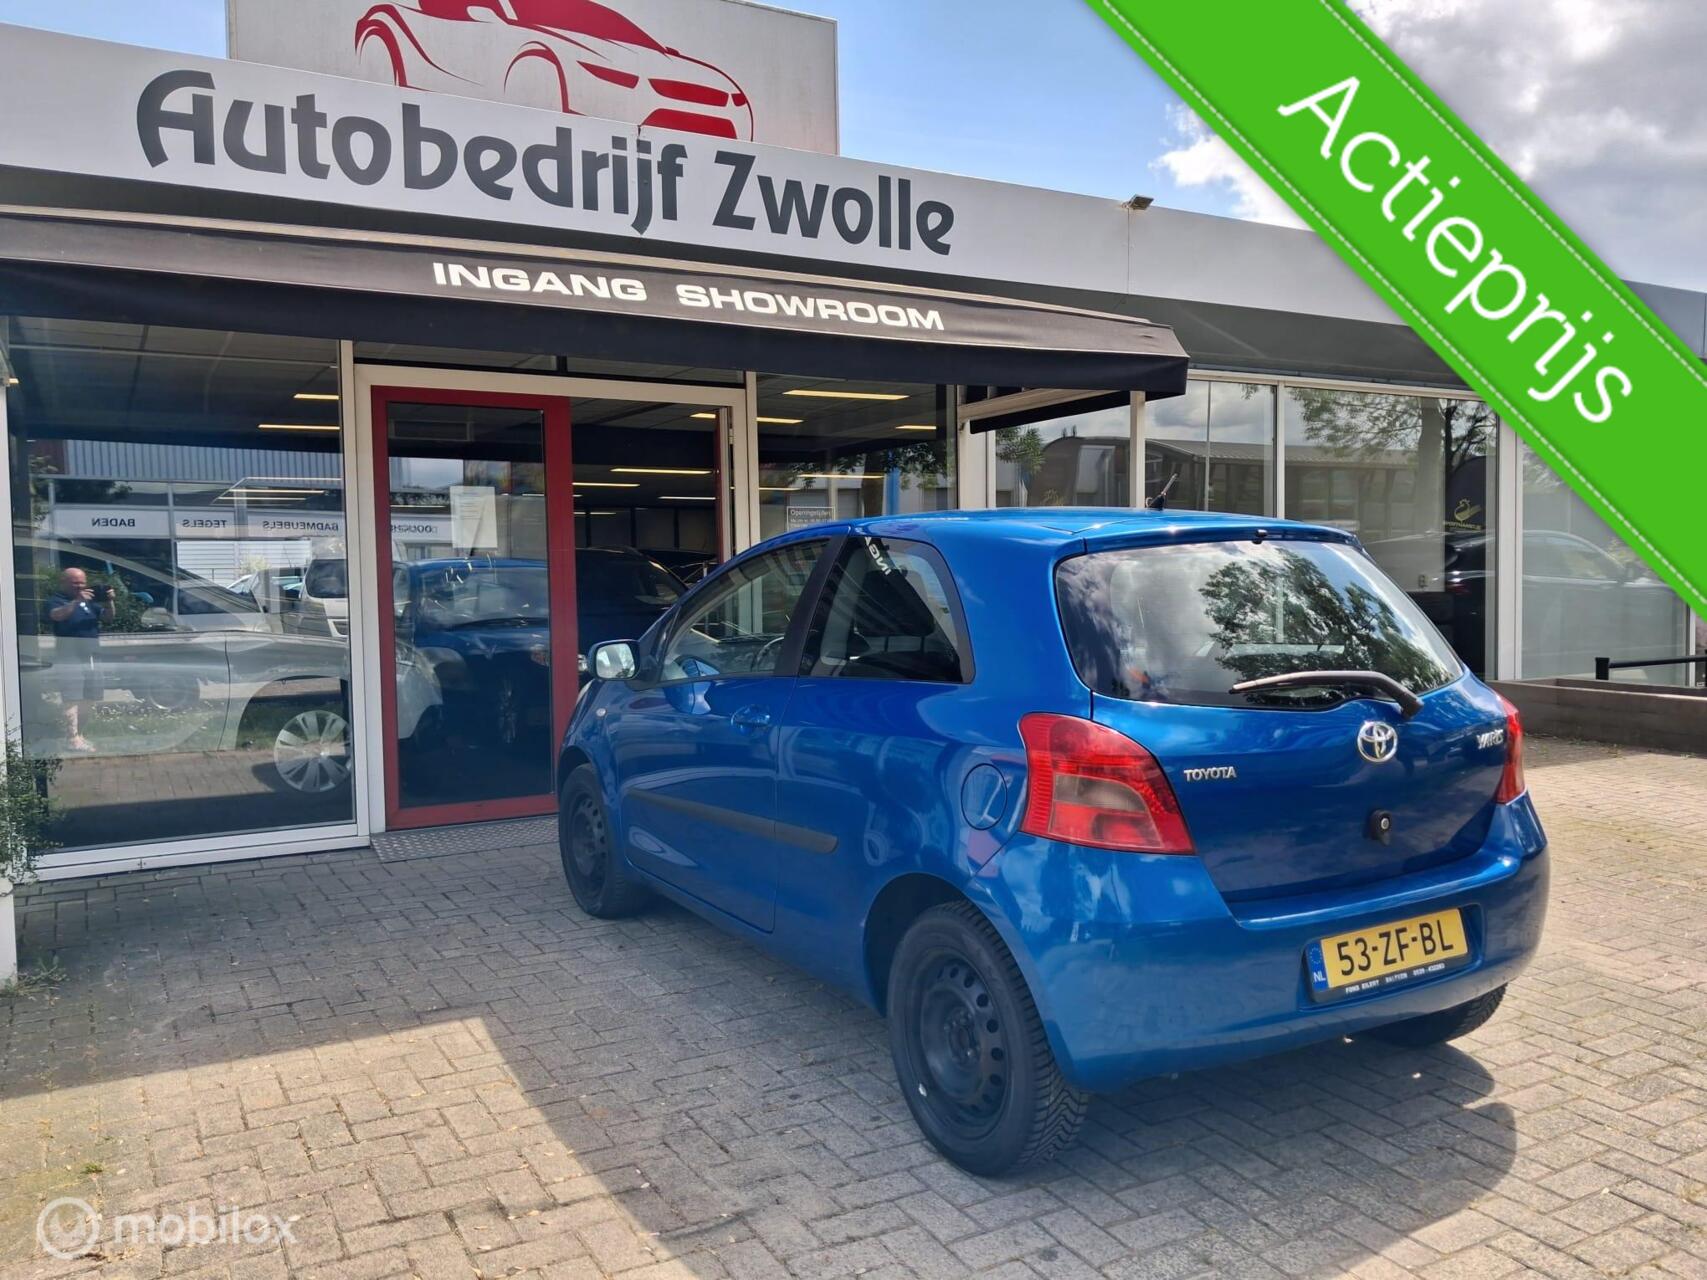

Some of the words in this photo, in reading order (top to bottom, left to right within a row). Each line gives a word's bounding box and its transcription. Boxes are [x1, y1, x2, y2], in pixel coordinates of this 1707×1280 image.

[136, 69, 687, 235] Autobedrijf
[712, 150, 955, 256] Zwolle
[432, 262, 648, 303] INGANG
[678, 284, 945, 331] SHOWROOM
[1183, 766, 1237, 782] TOYOTA
[1336, 919, 1454, 976] 53-ZF-BL
[1313, 972, 1326, 982] NL
